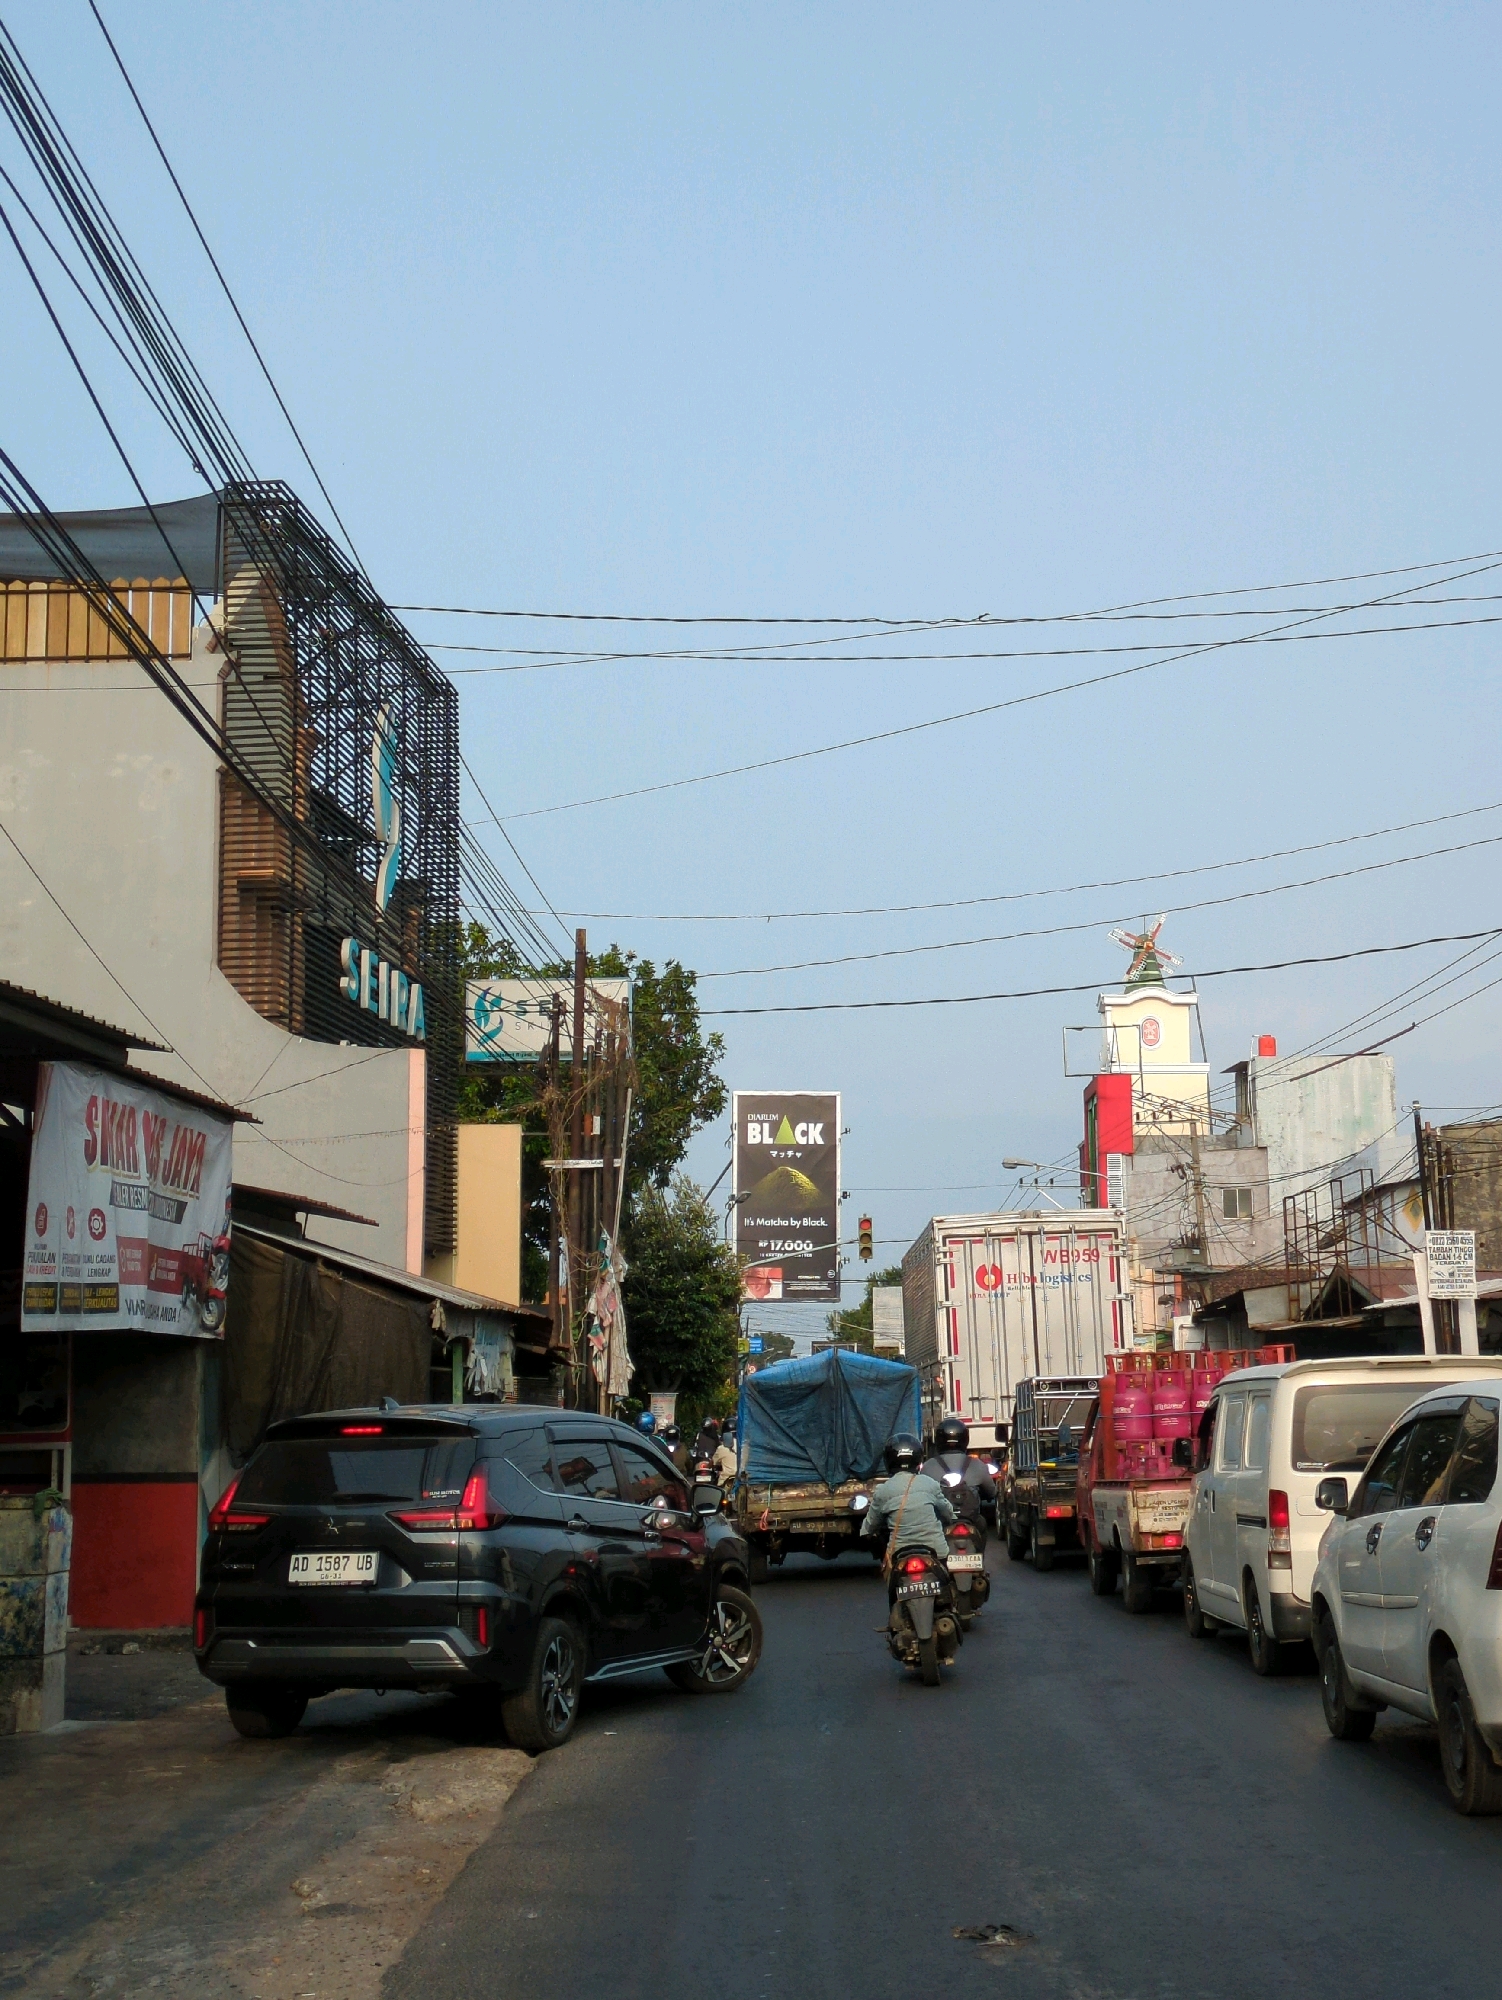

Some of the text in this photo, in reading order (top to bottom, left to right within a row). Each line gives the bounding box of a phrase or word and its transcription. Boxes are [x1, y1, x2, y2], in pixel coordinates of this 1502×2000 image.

[340, 938, 426, 1041] SEIRA
[747, 1113, 779, 1121] DJARUM
[161, 1124, 206, 1195] JAYA
[744, 1216, 829, 1229] It's Matcha by Black.
[769, 1240, 814, 1251] 17.000
[1040, 1247, 1100, 1264] WB959
[87, 1268, 112, 1278] LENGKAP
[292, 1555, 373, 1572] AD 1587 UB
